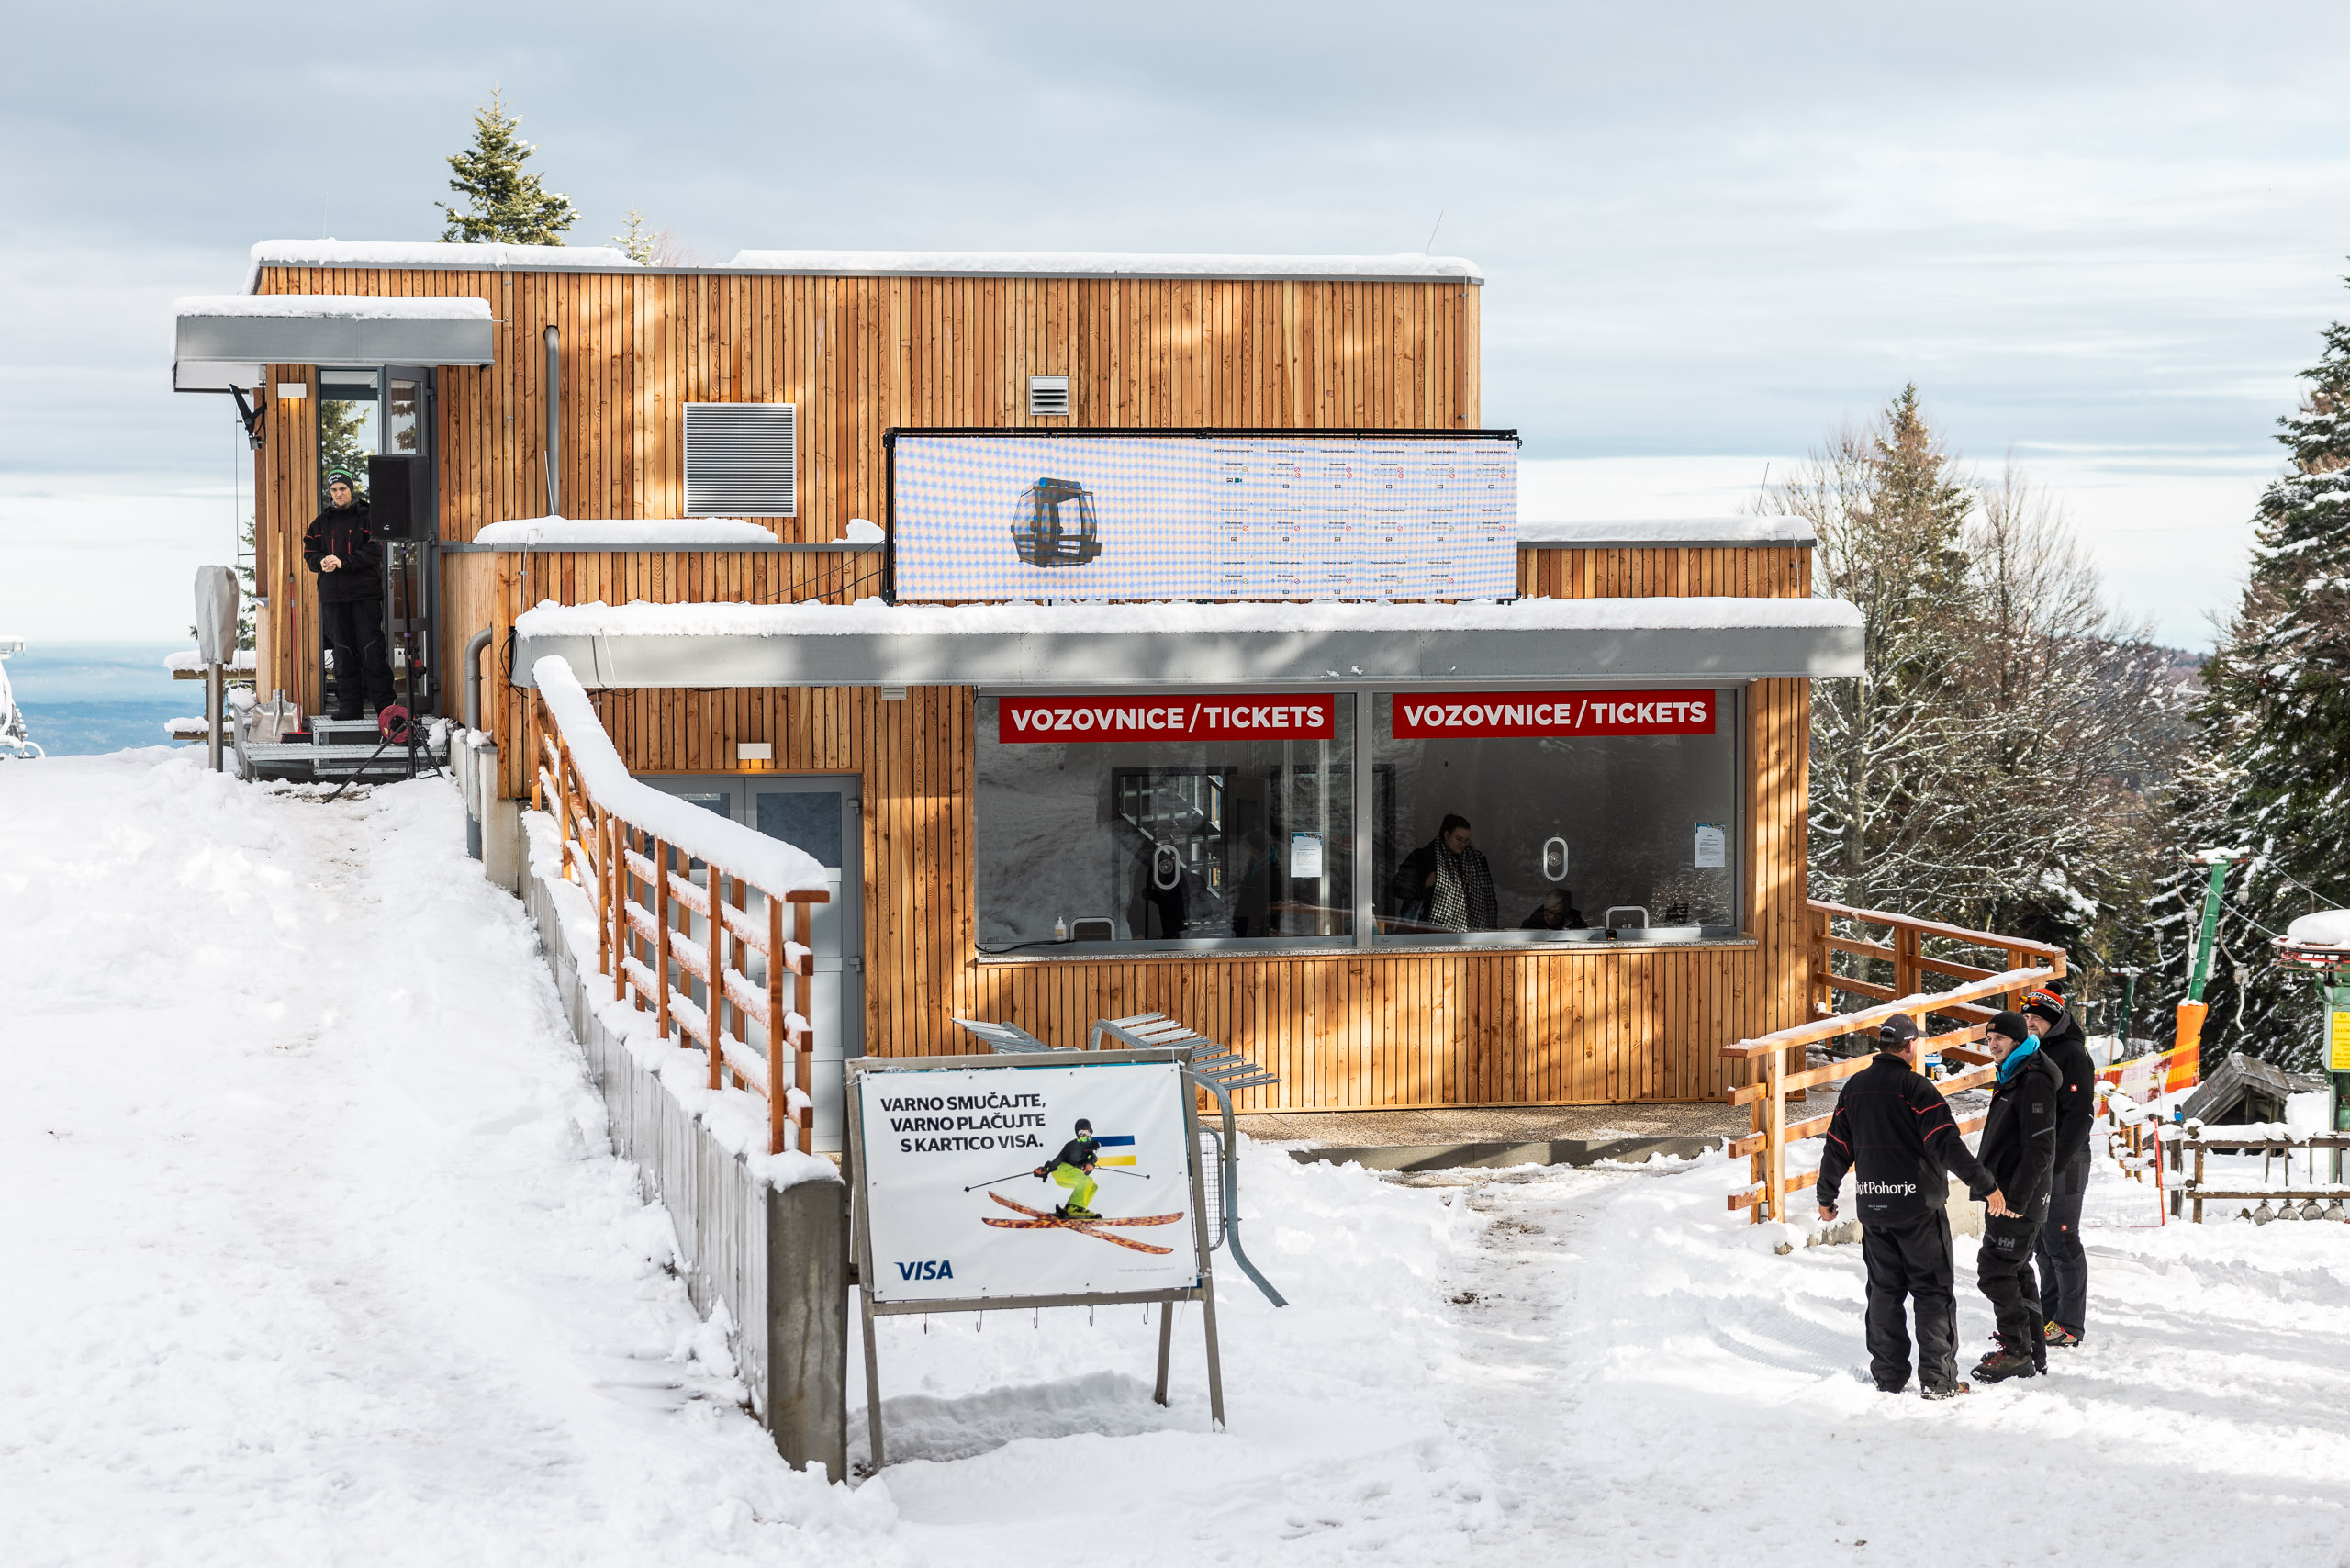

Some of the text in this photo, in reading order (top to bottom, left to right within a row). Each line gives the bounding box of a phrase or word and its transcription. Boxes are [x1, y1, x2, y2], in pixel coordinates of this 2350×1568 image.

[880, 1092, 1046, 1112] VARNO SMUČAJTE,
[890, 1112, 1046, 1132] VARNO PLAČUJTE
[901, 1134, 1044, 1153] S KARTICO VISA.
[893, 1260, 954, 1281] VISA
